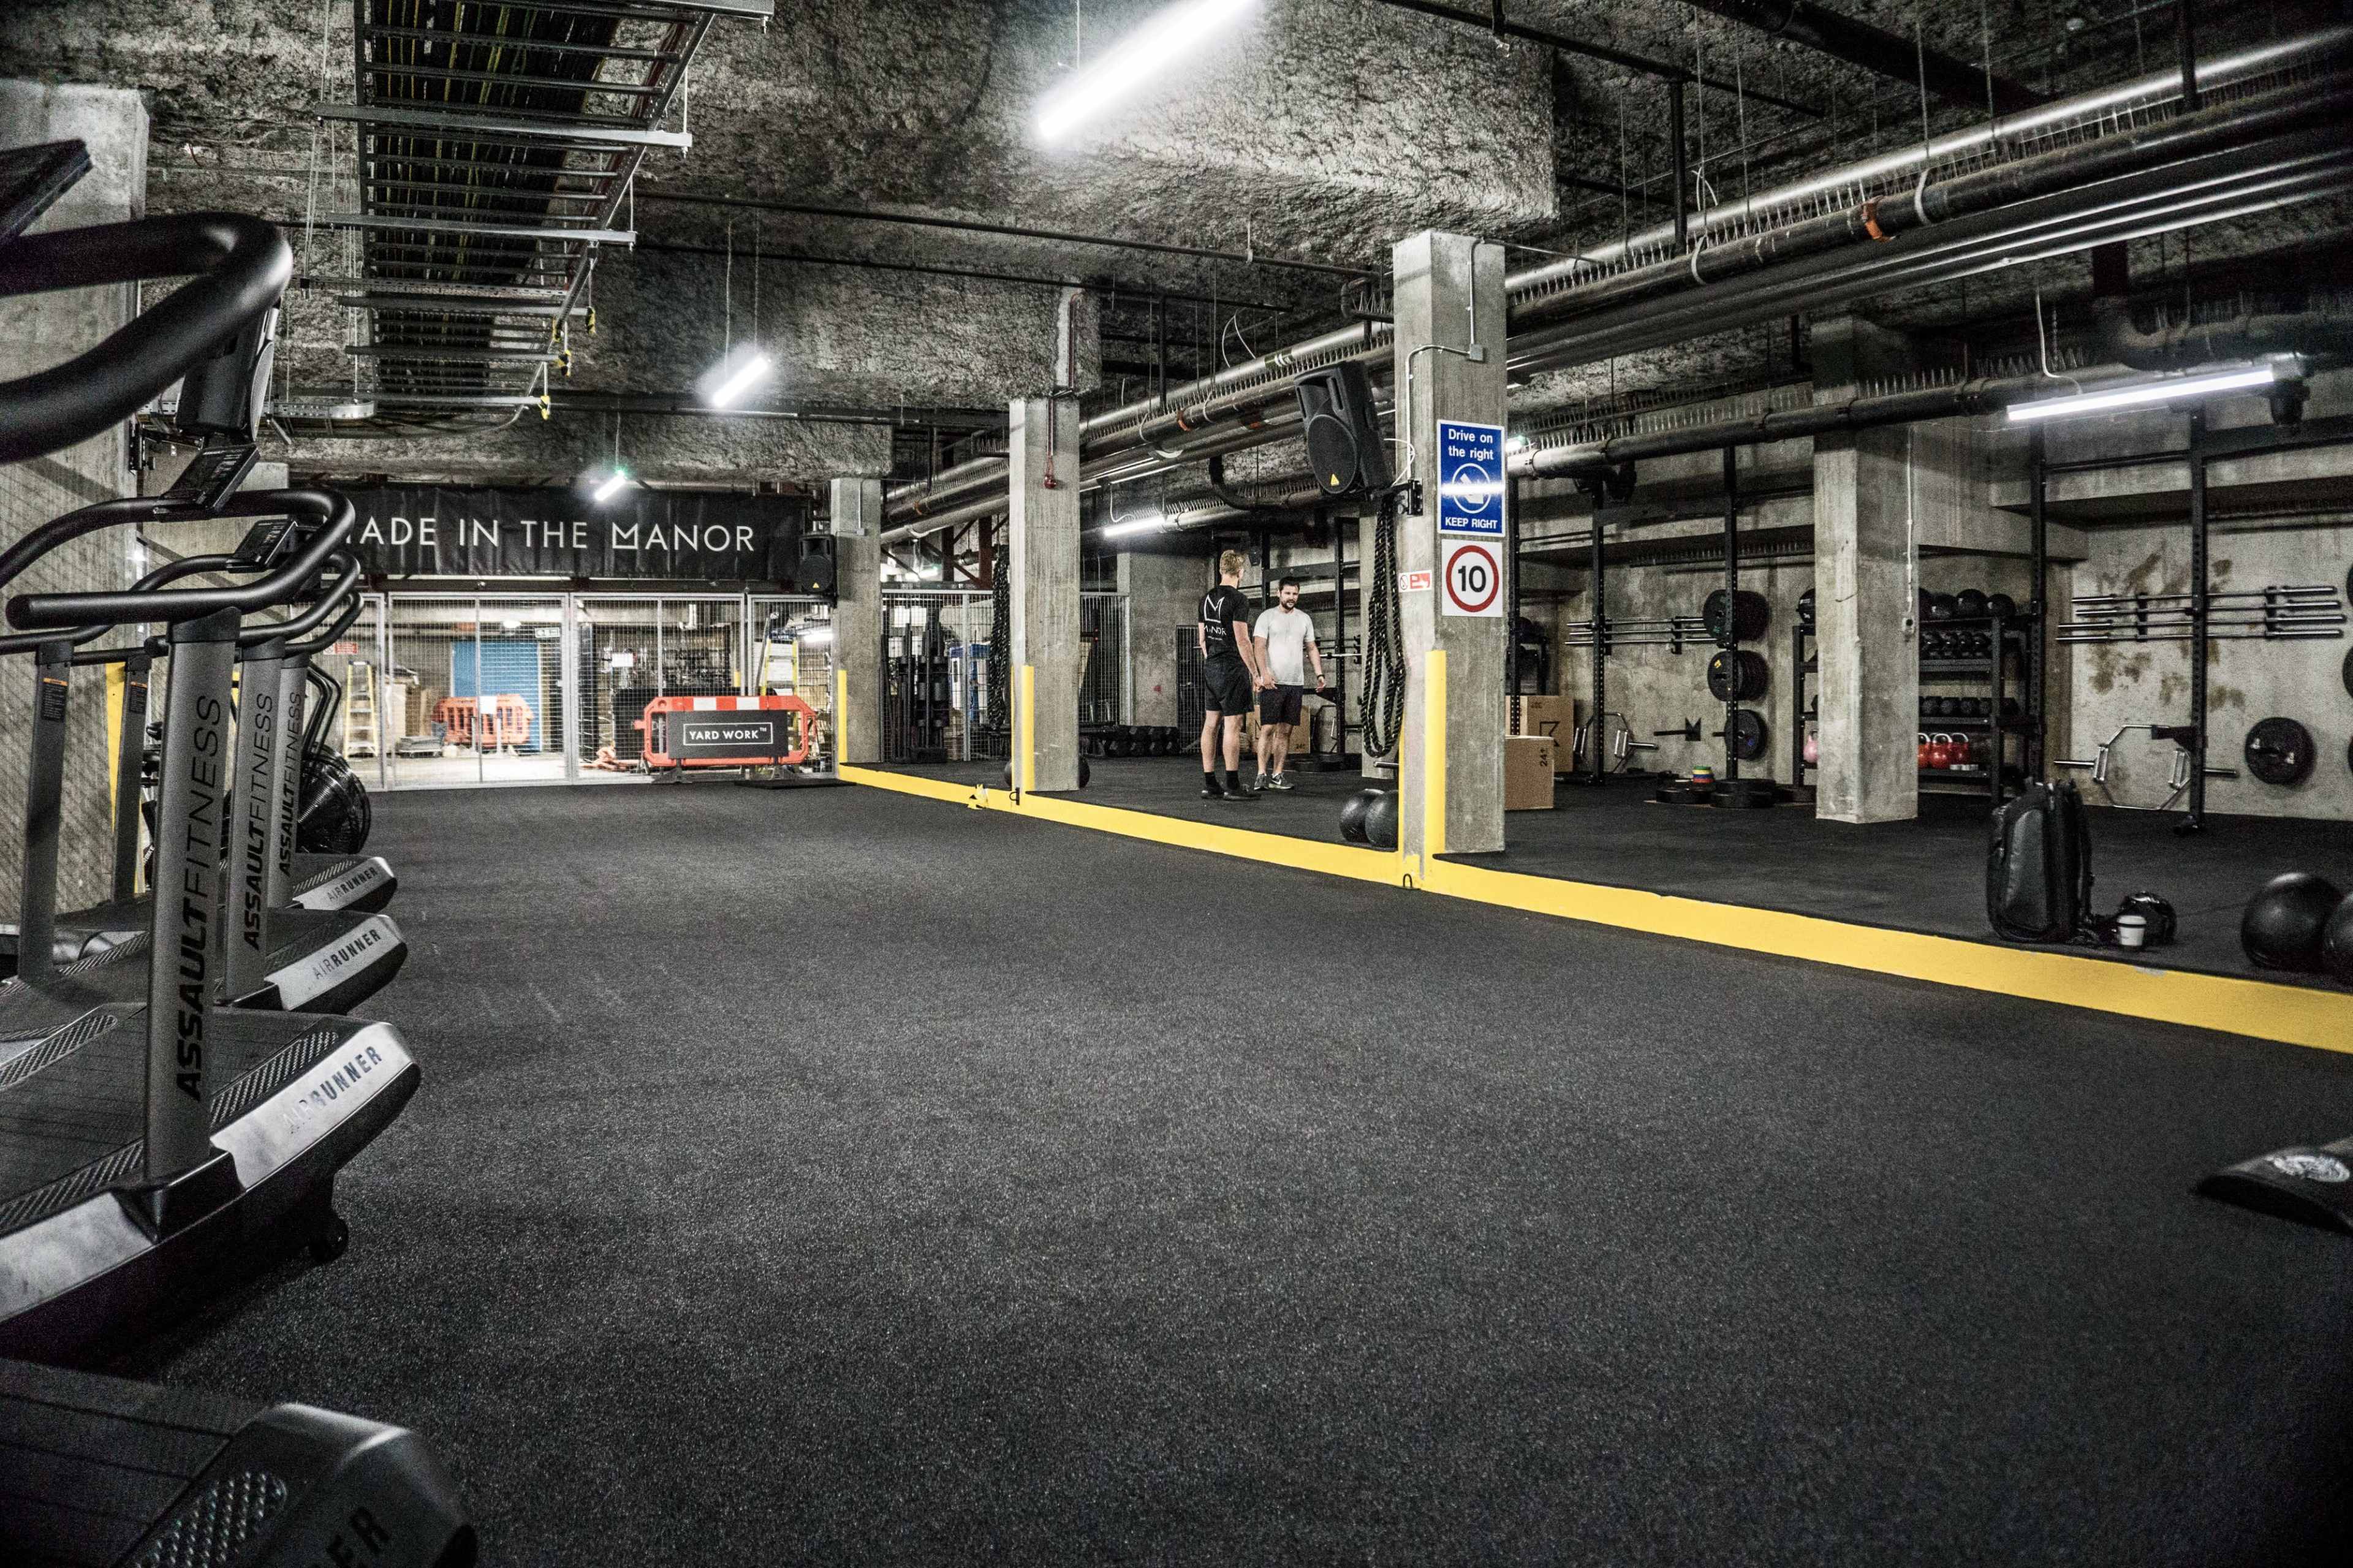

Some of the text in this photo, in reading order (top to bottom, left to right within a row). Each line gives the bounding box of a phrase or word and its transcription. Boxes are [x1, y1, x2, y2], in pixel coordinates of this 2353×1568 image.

[1448, 428, 1493, 444] Drive on
[1448, 445, 1494, 461] the right
[346, 516, 754, 552] ADE IN THE MANOR
[1445, 517, 1498, 529] KEEP RIGHT
[1458, 565, 1487, 593] 10
[689, 730, 719, 740] YARD
[279, 692, 302, 878] ASSAULTFITNESS
[244, 692, 273, 951] ASSAULTFITNESS
[176, 694, 221, 1102] ASSAULTFITNESS
[327, 867, 378, 901] AIRRUNNER
[313, 929, 381, 980] AIRRUNNER
